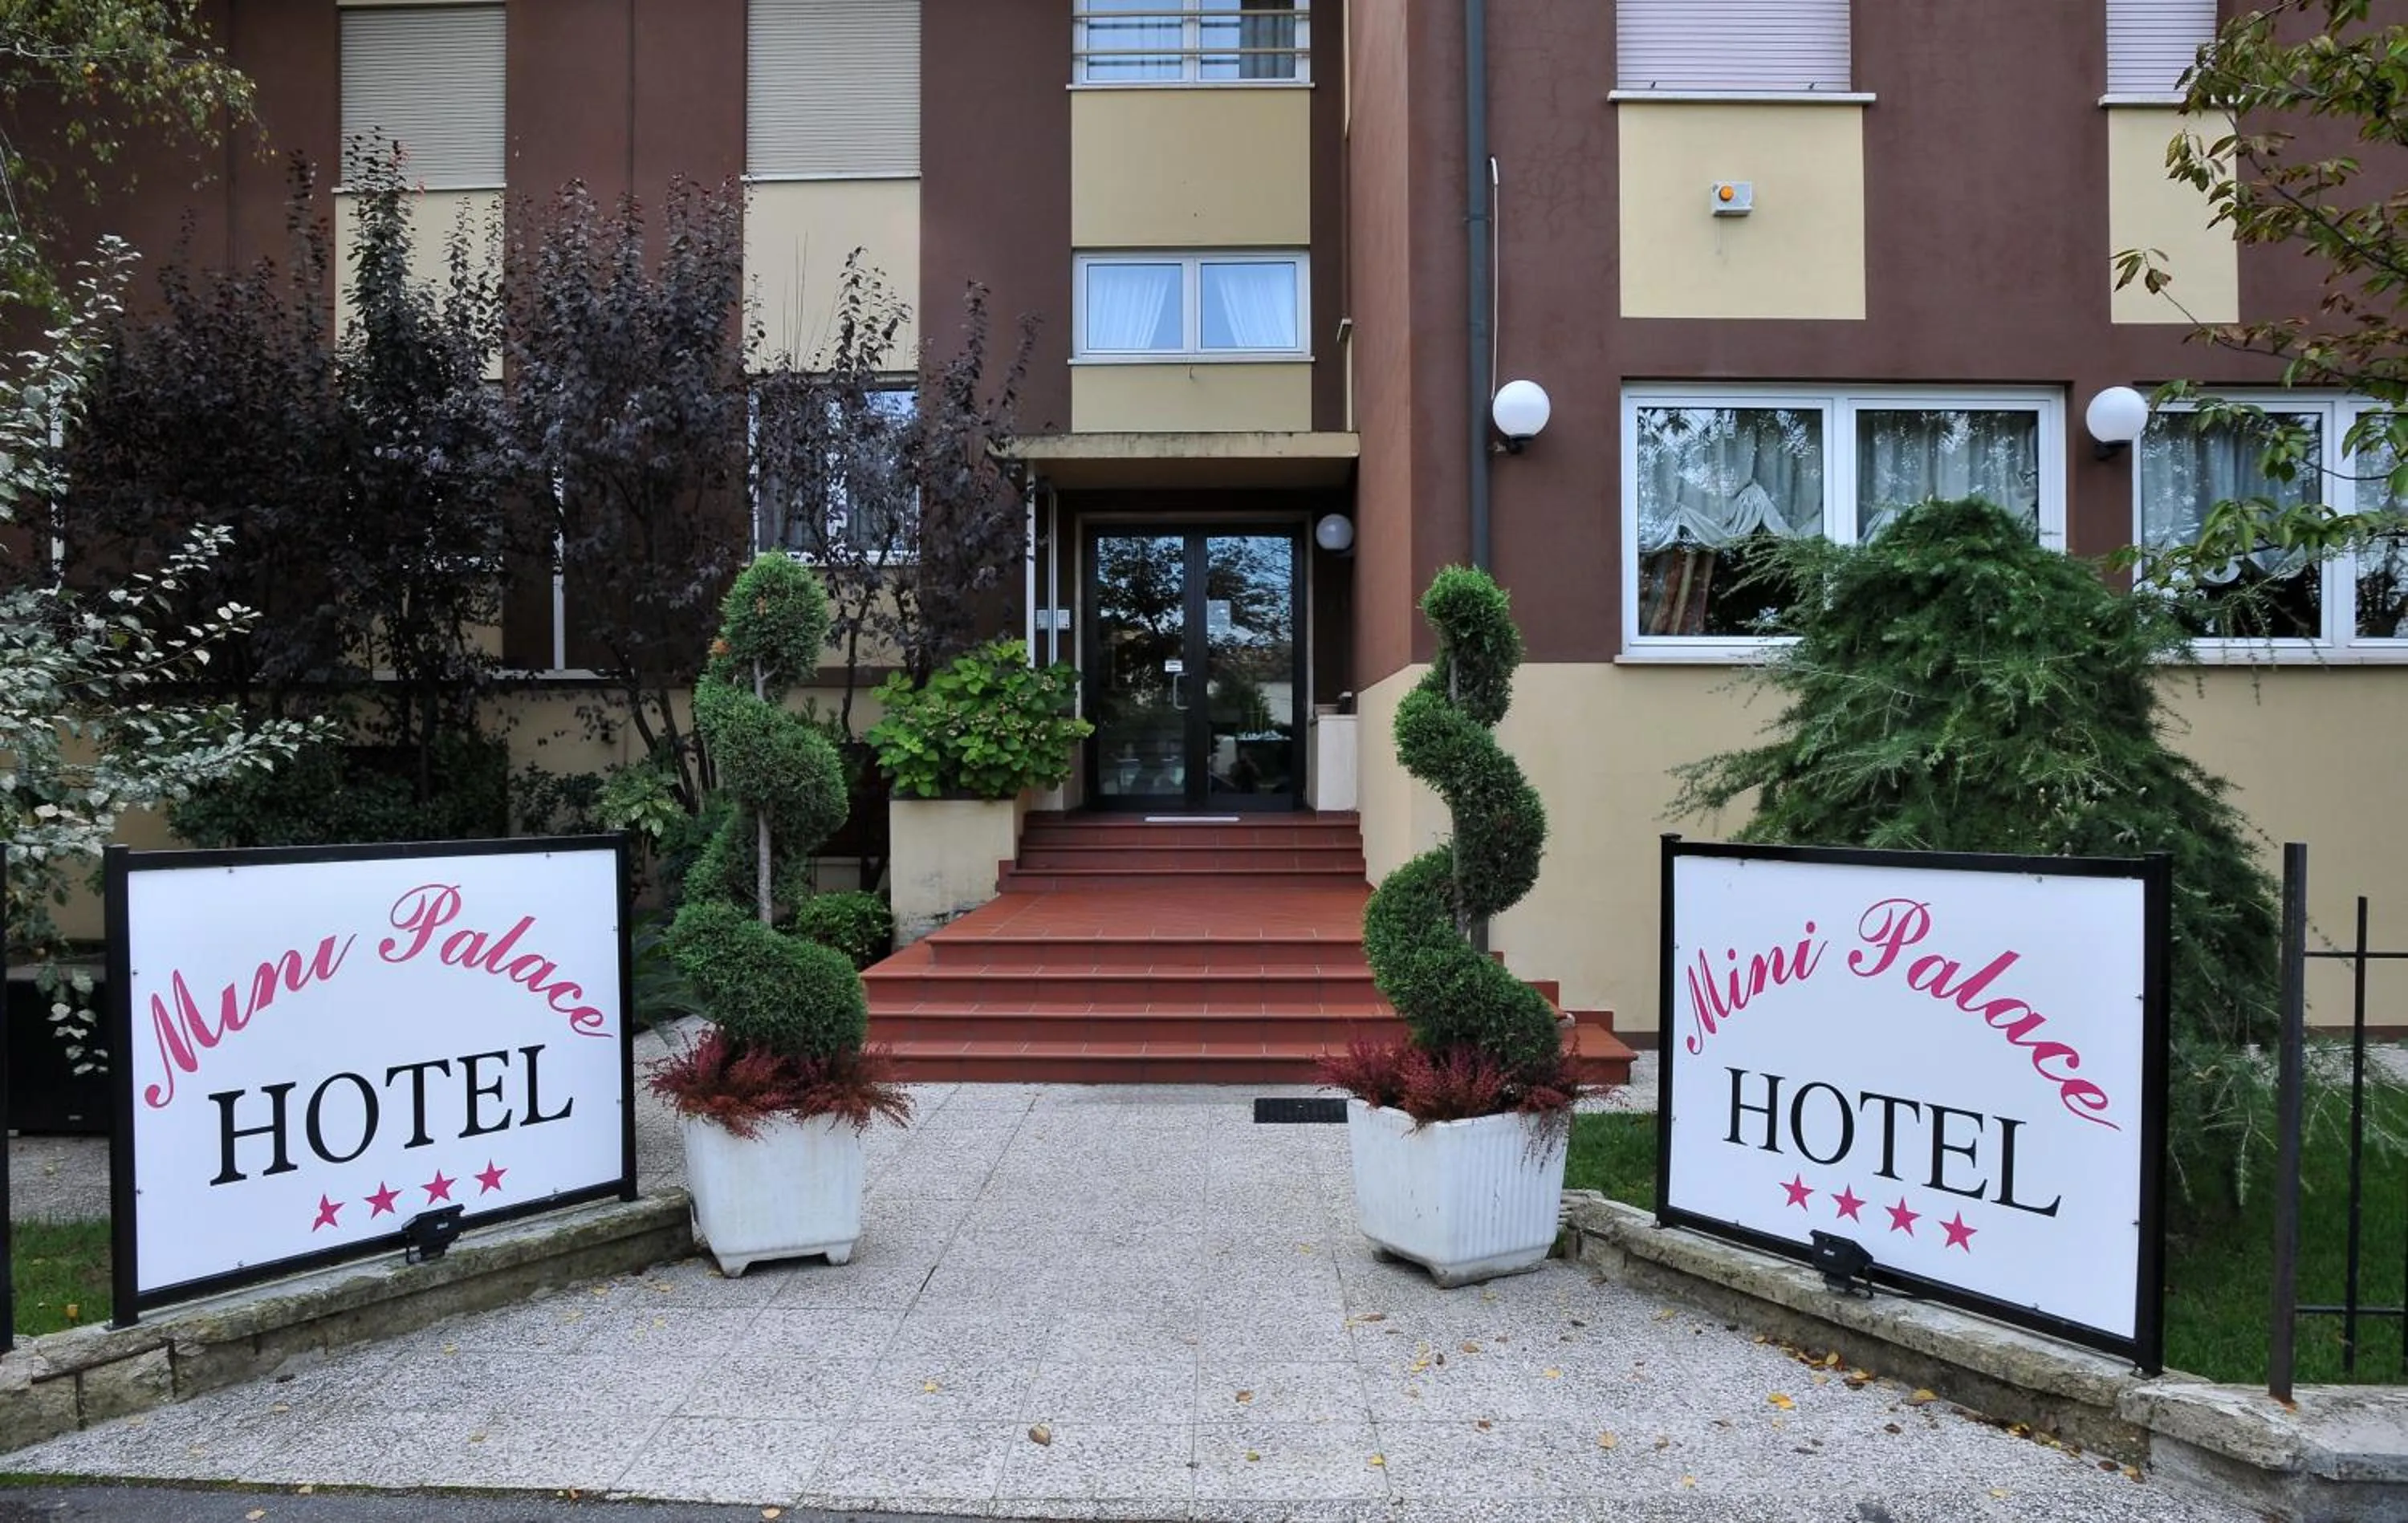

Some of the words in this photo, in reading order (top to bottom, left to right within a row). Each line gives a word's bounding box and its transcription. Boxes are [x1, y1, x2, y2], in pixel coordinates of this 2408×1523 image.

[378, 883, 614, 1038] Palace
[1686, 920, 1828, 1055] Mini
[1848, 898, 2121, 1131] Palace
[208, 1044, 573, 1186] HOTEL
[1723, 1066, 2062, 1218] HOTEL
